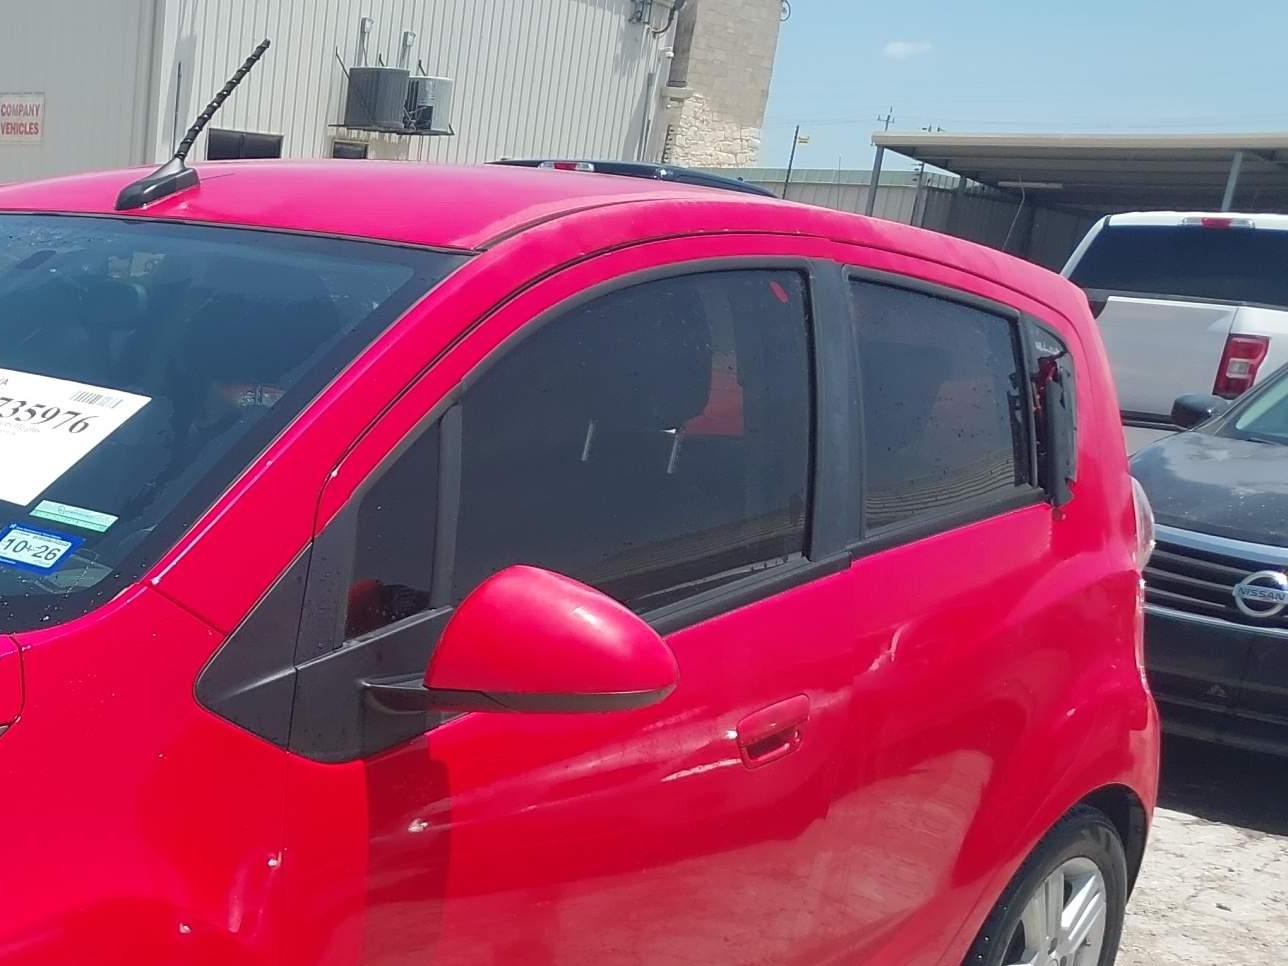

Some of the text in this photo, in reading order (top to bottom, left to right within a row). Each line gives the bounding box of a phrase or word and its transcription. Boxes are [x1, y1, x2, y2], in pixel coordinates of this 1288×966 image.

[0, 103, 41, 117] COMPANY
[0, 122, 40, 135] VEHICLES
[1238, 587, 1286, 601] NISSAN
